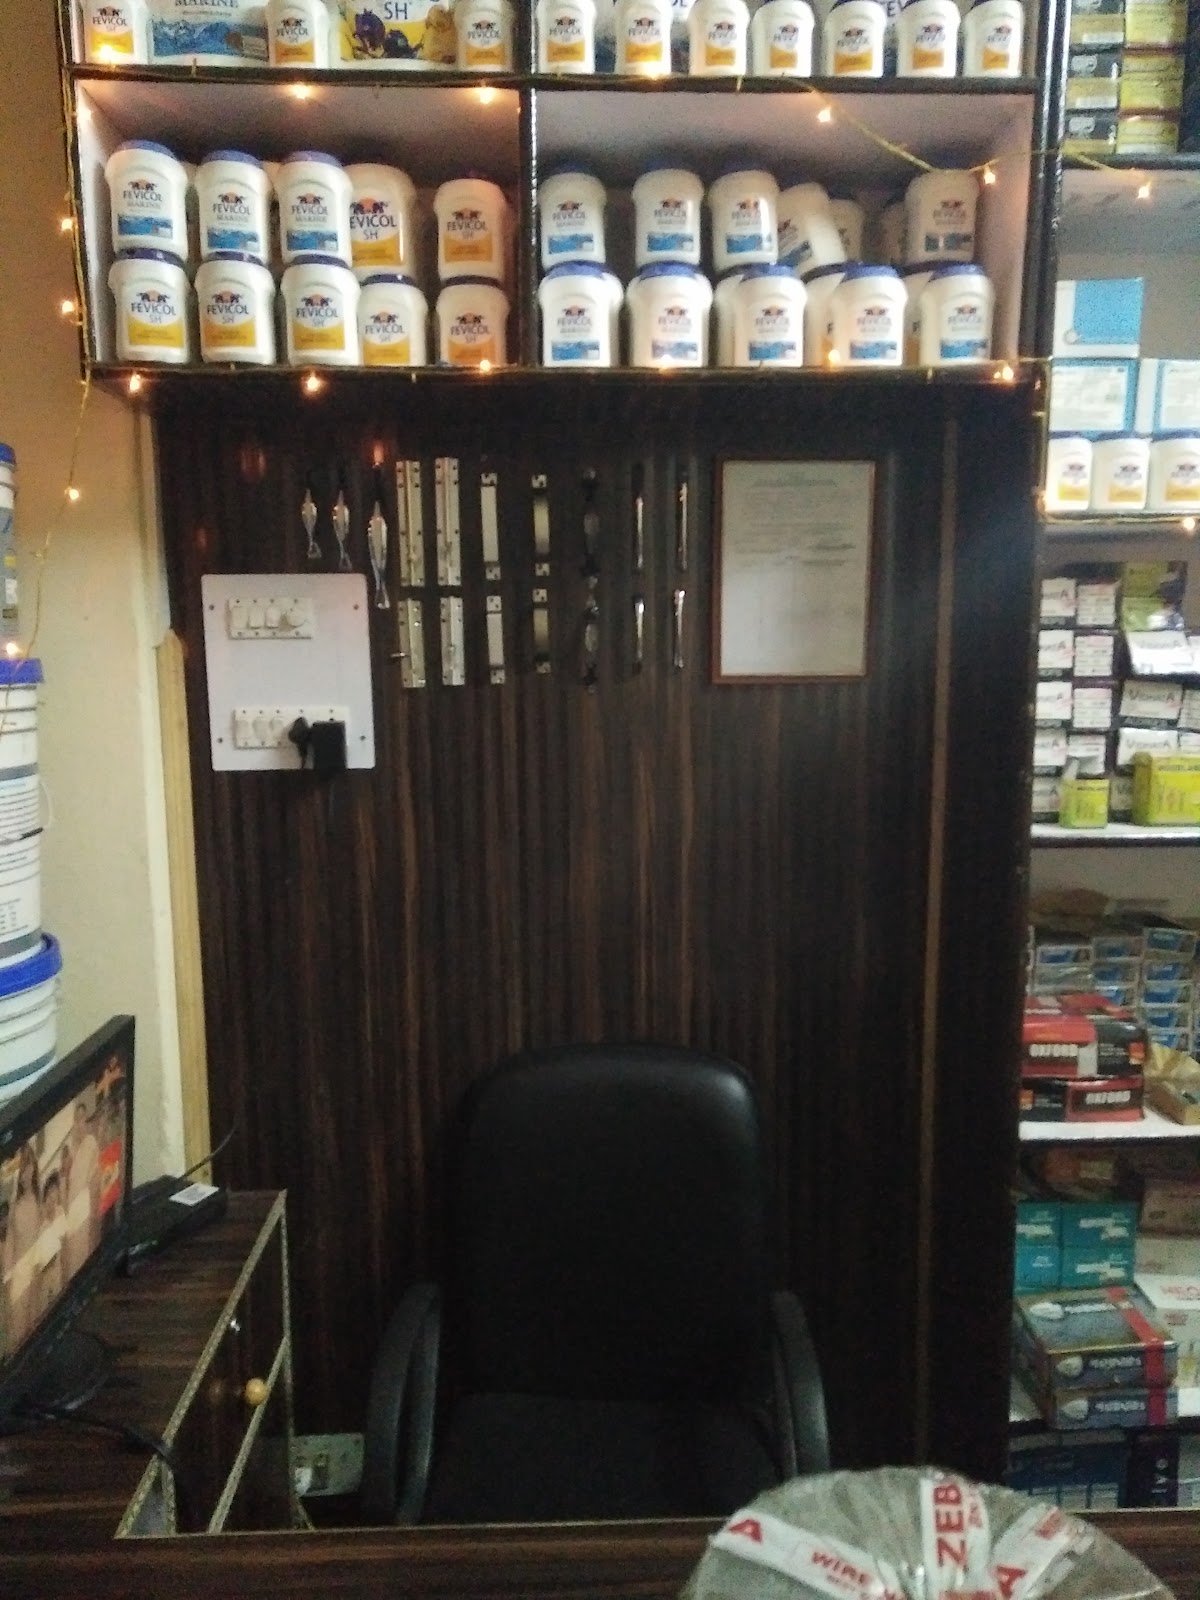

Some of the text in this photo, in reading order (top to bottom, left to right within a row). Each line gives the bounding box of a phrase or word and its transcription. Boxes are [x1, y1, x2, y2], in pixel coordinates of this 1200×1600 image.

[385, 1, 408, 20] SH
[92, 17, 127, 26] FEVICOL
[123, 190, 163, 202] FEVICOL
[212, 203, 251, 215] FEVICOL
[291, 205, 329, 215] FEVICOL
[350, 215, 397, 229] EVICOL
[447, 220, 488, 231] FEVICOL
[363, 230, 378, 241] SH
[131, 302, 176, 315] FEVICOL
[206, 303, 250, 315] FEVICOL
[296, 307, 338, 318] FEVICOL
[365, 323, 405, 334] FEVICOL
[450, 325, 490, 336] FEVICOL
